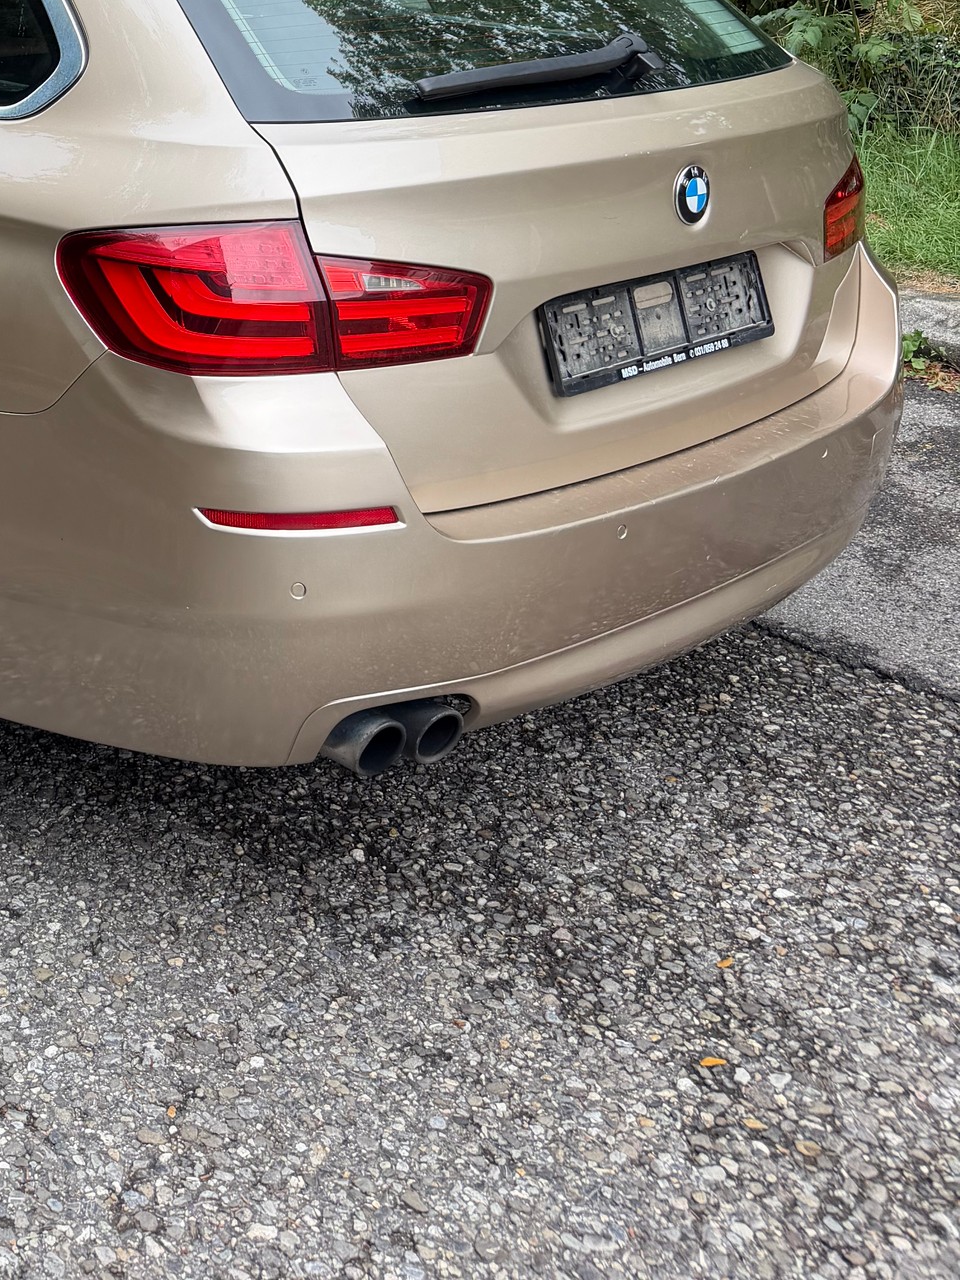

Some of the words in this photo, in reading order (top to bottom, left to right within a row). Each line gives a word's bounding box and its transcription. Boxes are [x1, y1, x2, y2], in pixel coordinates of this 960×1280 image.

[621, 365, 638, 378] MSD
[643, 356, 672, 372] Automobile
[672, 352, 686, 363] Bern
[714, 340, 722, 350] 24
